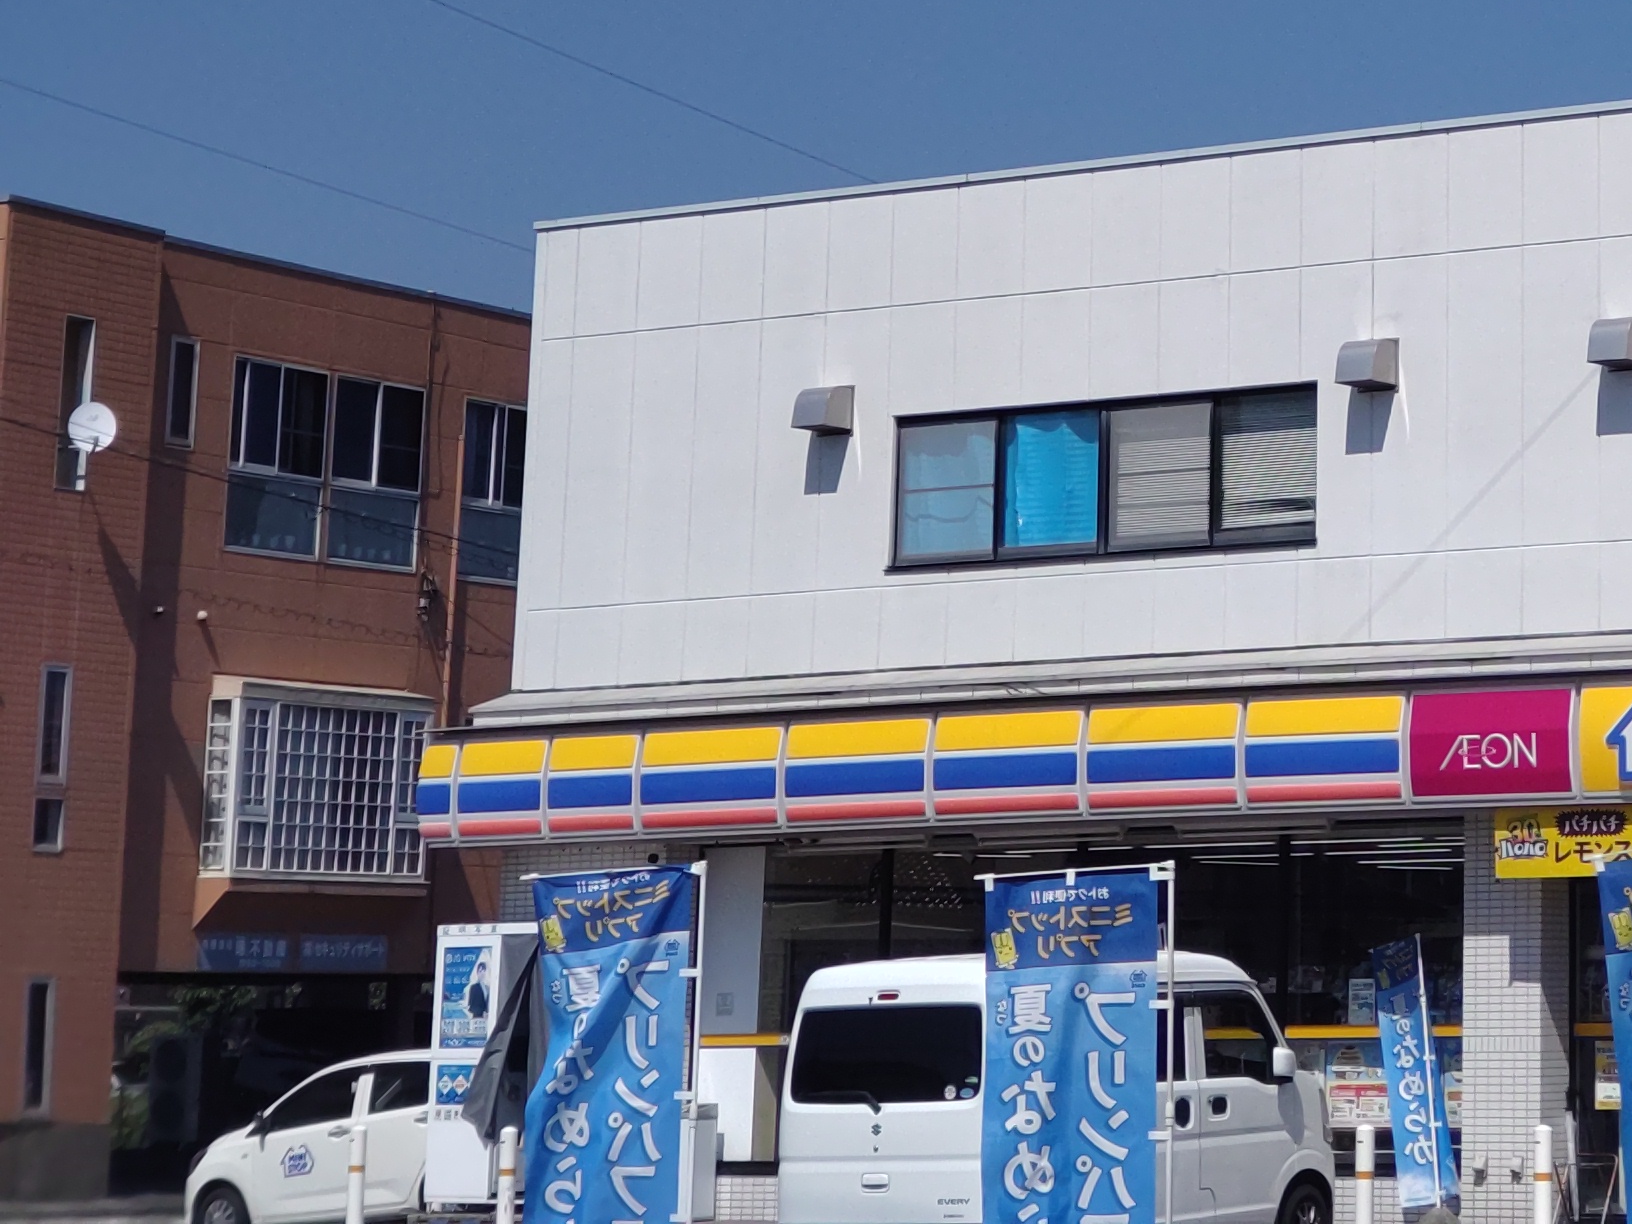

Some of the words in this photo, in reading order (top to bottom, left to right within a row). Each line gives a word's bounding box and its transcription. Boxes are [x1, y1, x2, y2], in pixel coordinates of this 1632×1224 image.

[1564, 814, 1621, 833] パチパチ
[937, 1198, 970, 1206] EVERY
